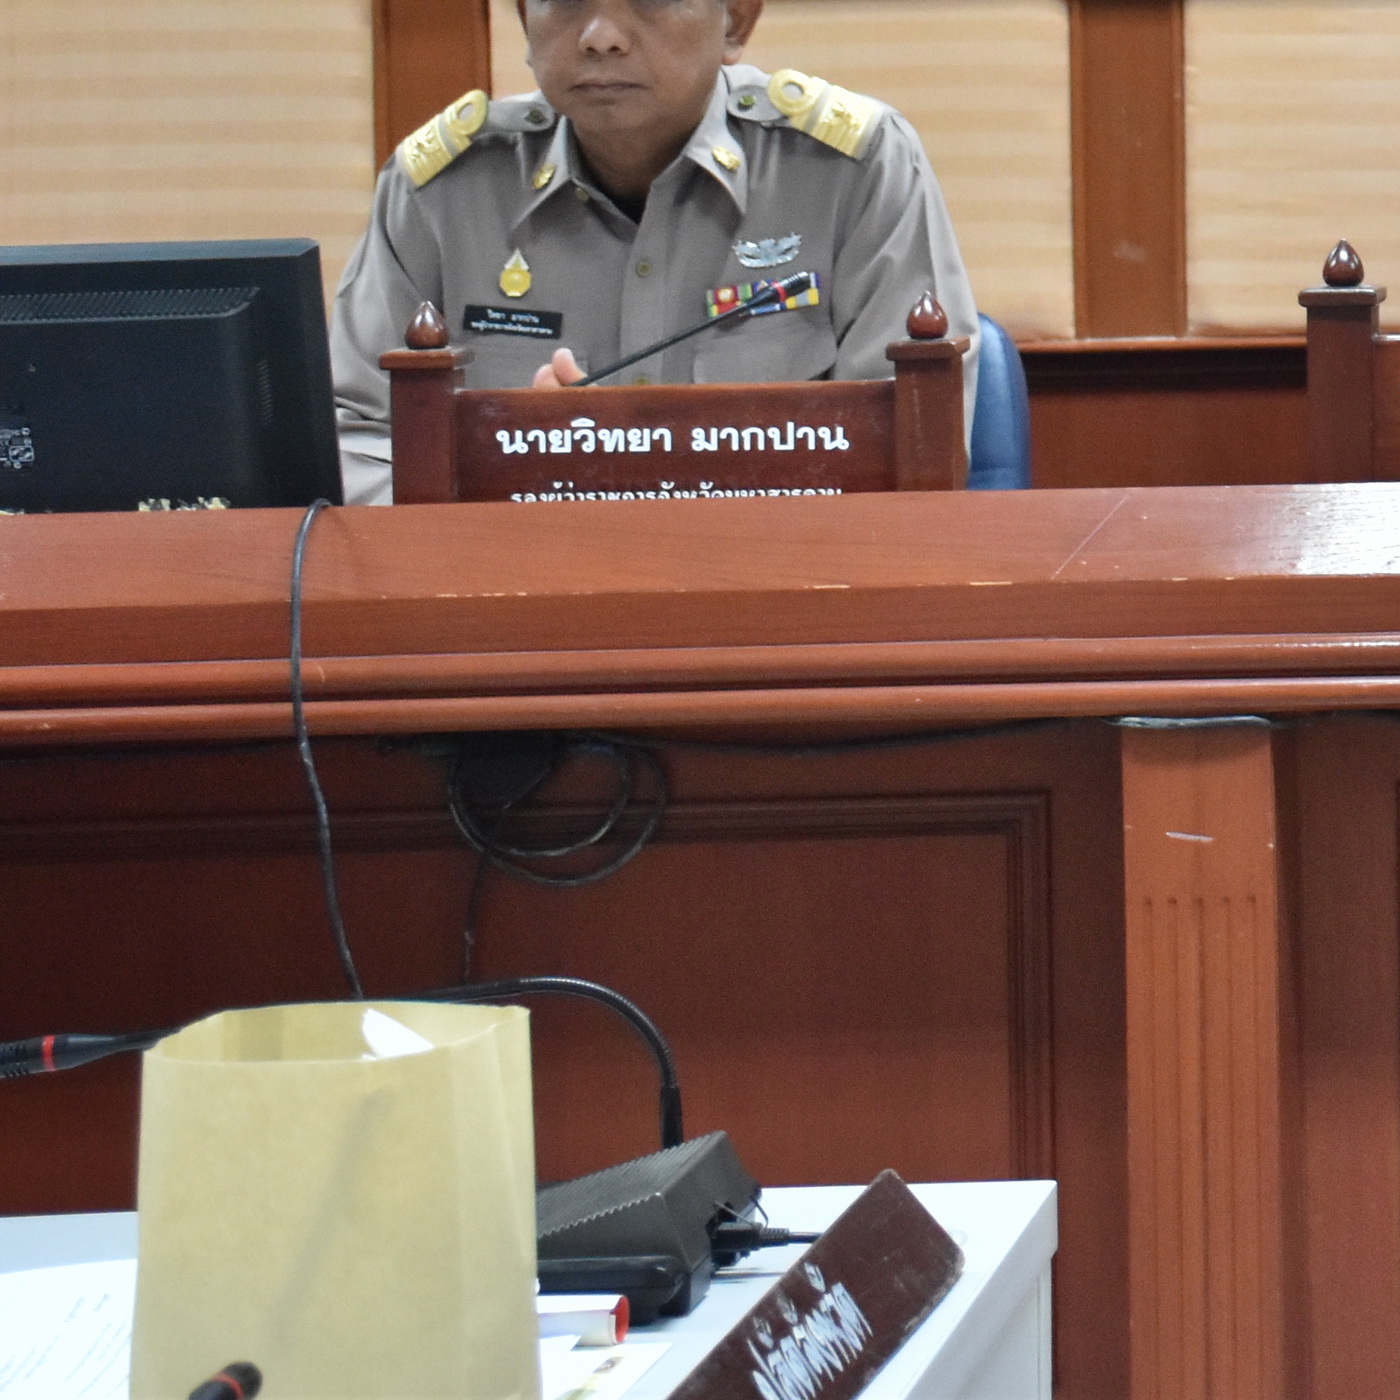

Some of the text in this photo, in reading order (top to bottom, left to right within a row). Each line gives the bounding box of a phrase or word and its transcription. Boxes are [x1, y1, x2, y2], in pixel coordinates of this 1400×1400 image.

[495, 416, 851, 455] นายวิทยา มากปาน
